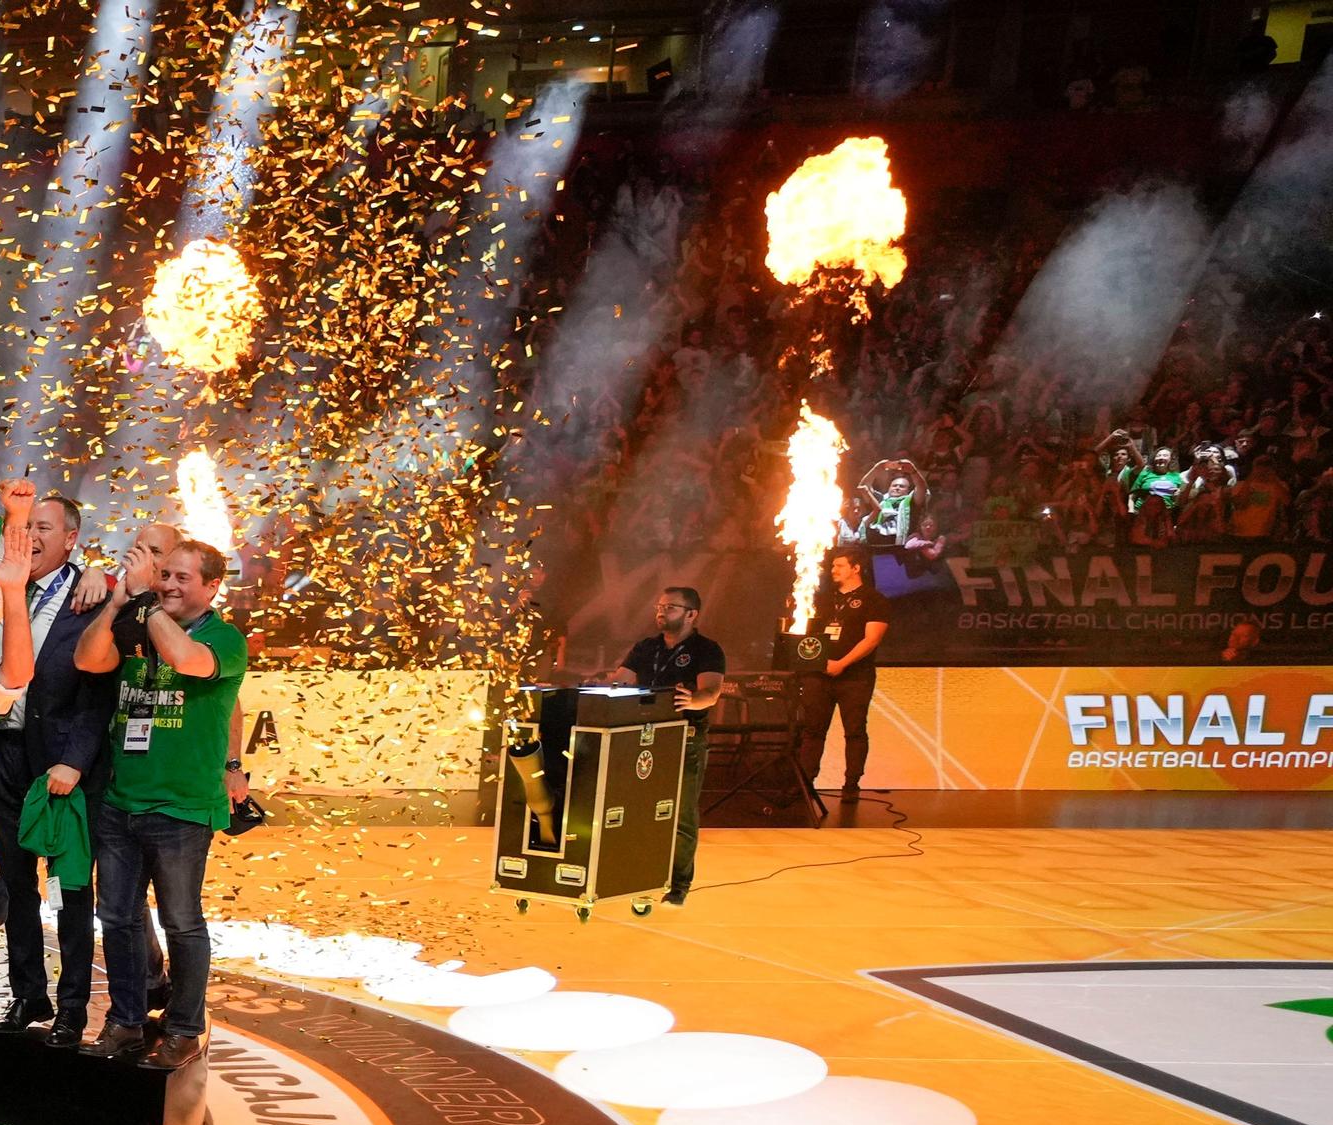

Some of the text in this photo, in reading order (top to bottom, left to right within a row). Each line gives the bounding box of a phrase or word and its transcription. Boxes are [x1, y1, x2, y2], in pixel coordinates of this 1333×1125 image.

[945, 554, 1178, 607] FINAL
[1064, 694, 1286, 746] FINAL
[1068, 751, 1227, 768] BASKETBALL
